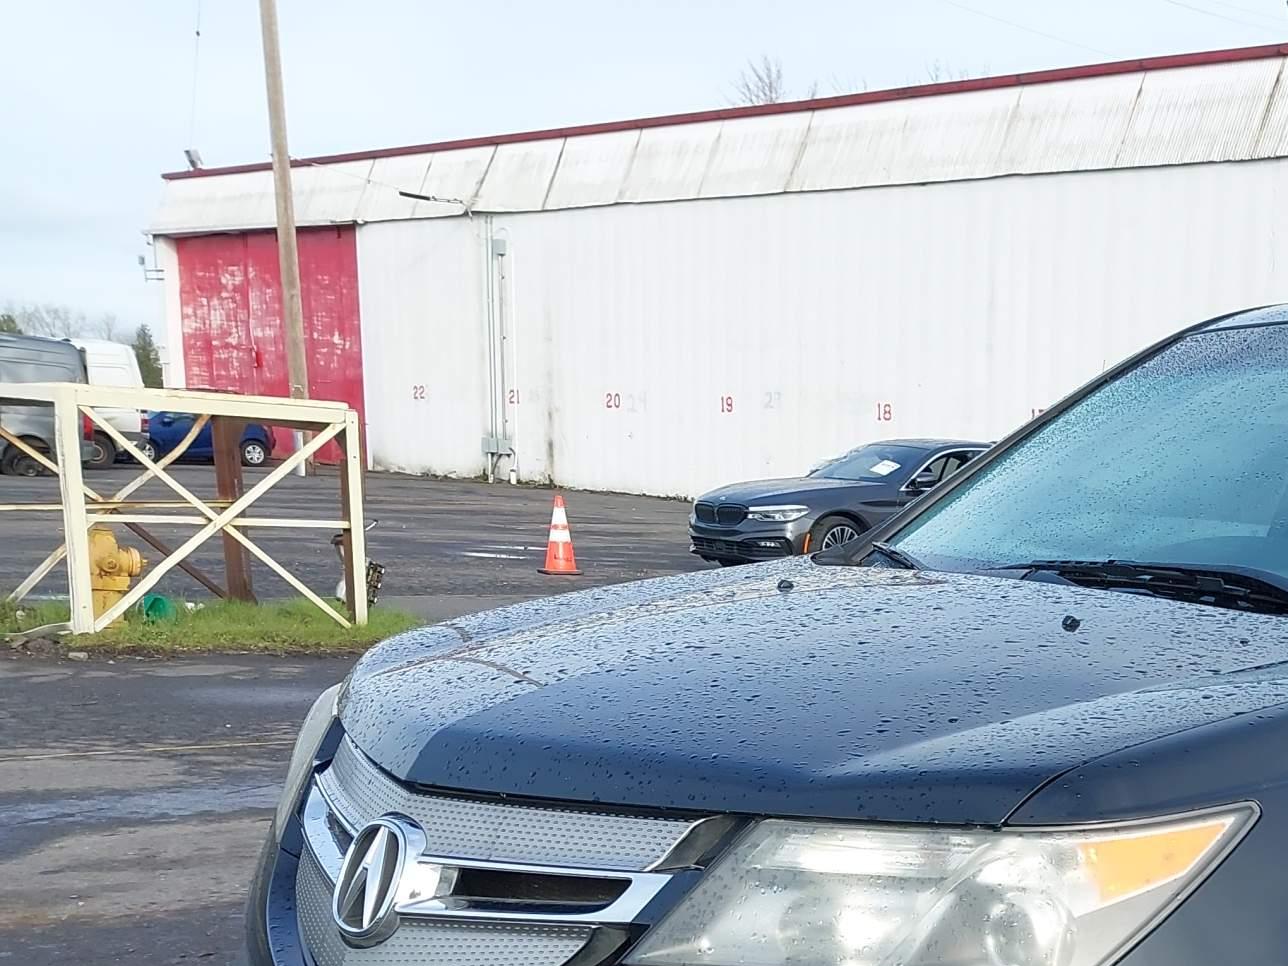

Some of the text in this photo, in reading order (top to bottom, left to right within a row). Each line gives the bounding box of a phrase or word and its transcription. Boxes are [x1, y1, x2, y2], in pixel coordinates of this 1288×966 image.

[413, 385, 425, 400] 22
[508, 389, 520, 405] 21
[606, 392, 621, 409] 20
[720, 396, 733, 413] 19
[877, 402, 892, 421] 18
